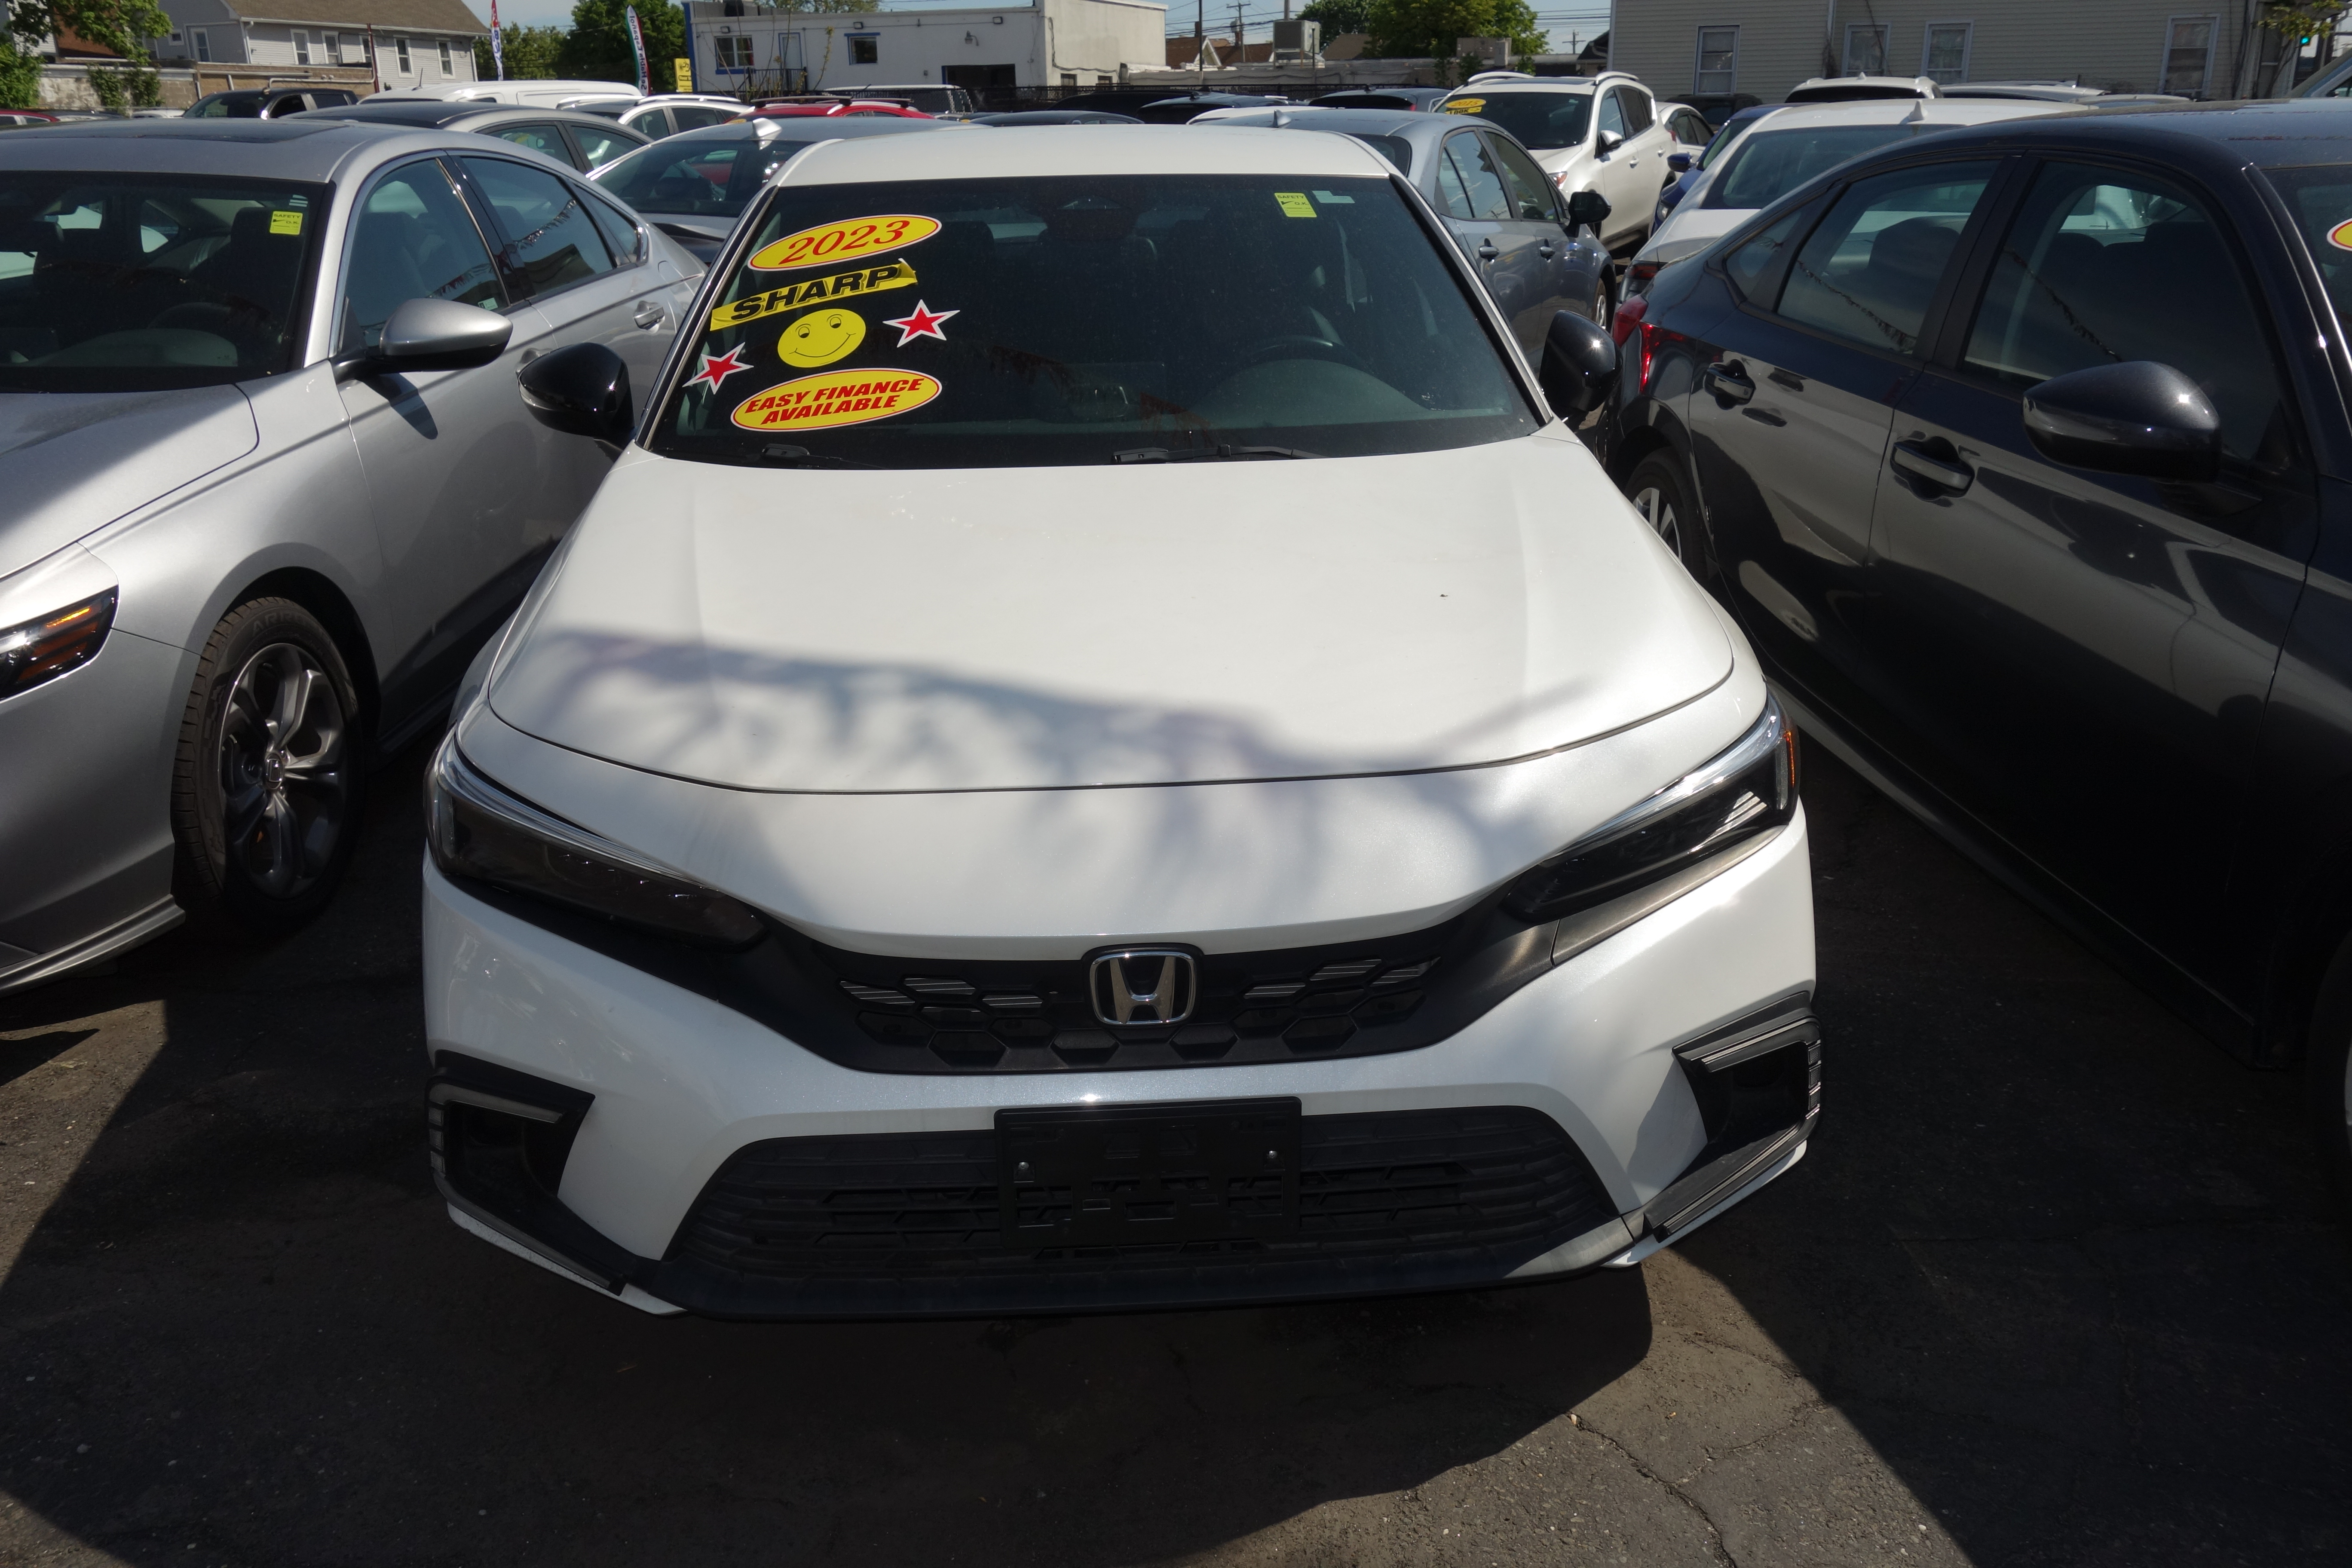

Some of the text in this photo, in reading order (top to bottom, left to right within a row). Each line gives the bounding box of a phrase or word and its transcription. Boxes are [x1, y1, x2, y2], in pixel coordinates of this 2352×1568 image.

[778, 220, 910, 265] 2023
[731, 266, 902, 322] SHARP
[744, 378, 925, 413] EASY FINANCE
[760, 395, 901, 425] AVAILABLE
